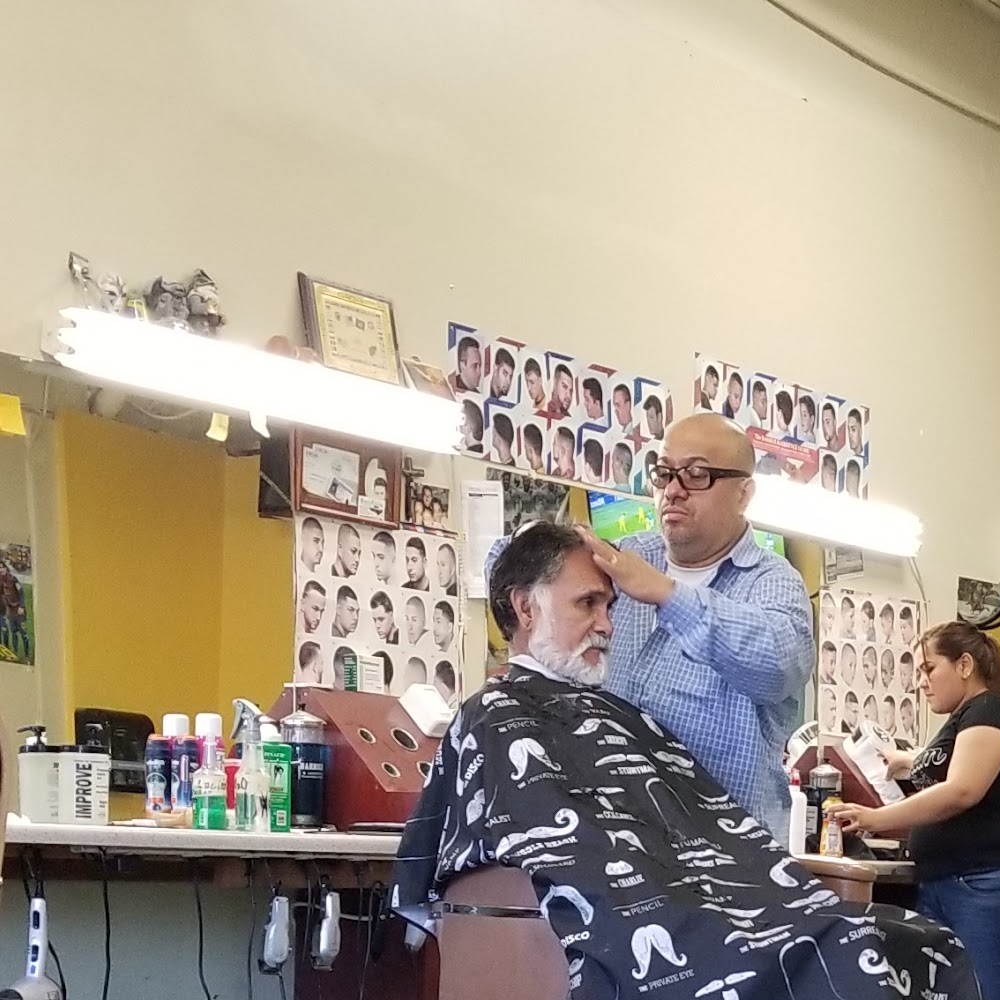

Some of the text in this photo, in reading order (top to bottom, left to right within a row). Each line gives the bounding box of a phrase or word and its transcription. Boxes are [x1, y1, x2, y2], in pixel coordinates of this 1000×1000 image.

[507, 720, 540, 731] PENCIL
[75, 763, 92, 819] IMPROVE
[630, 900, 664, 915] PENCIL
[560, 930, 590, 948] DISCO
[648, 974, 680, 990] PRIVATE
[680, 968, 695, 980] EYE
